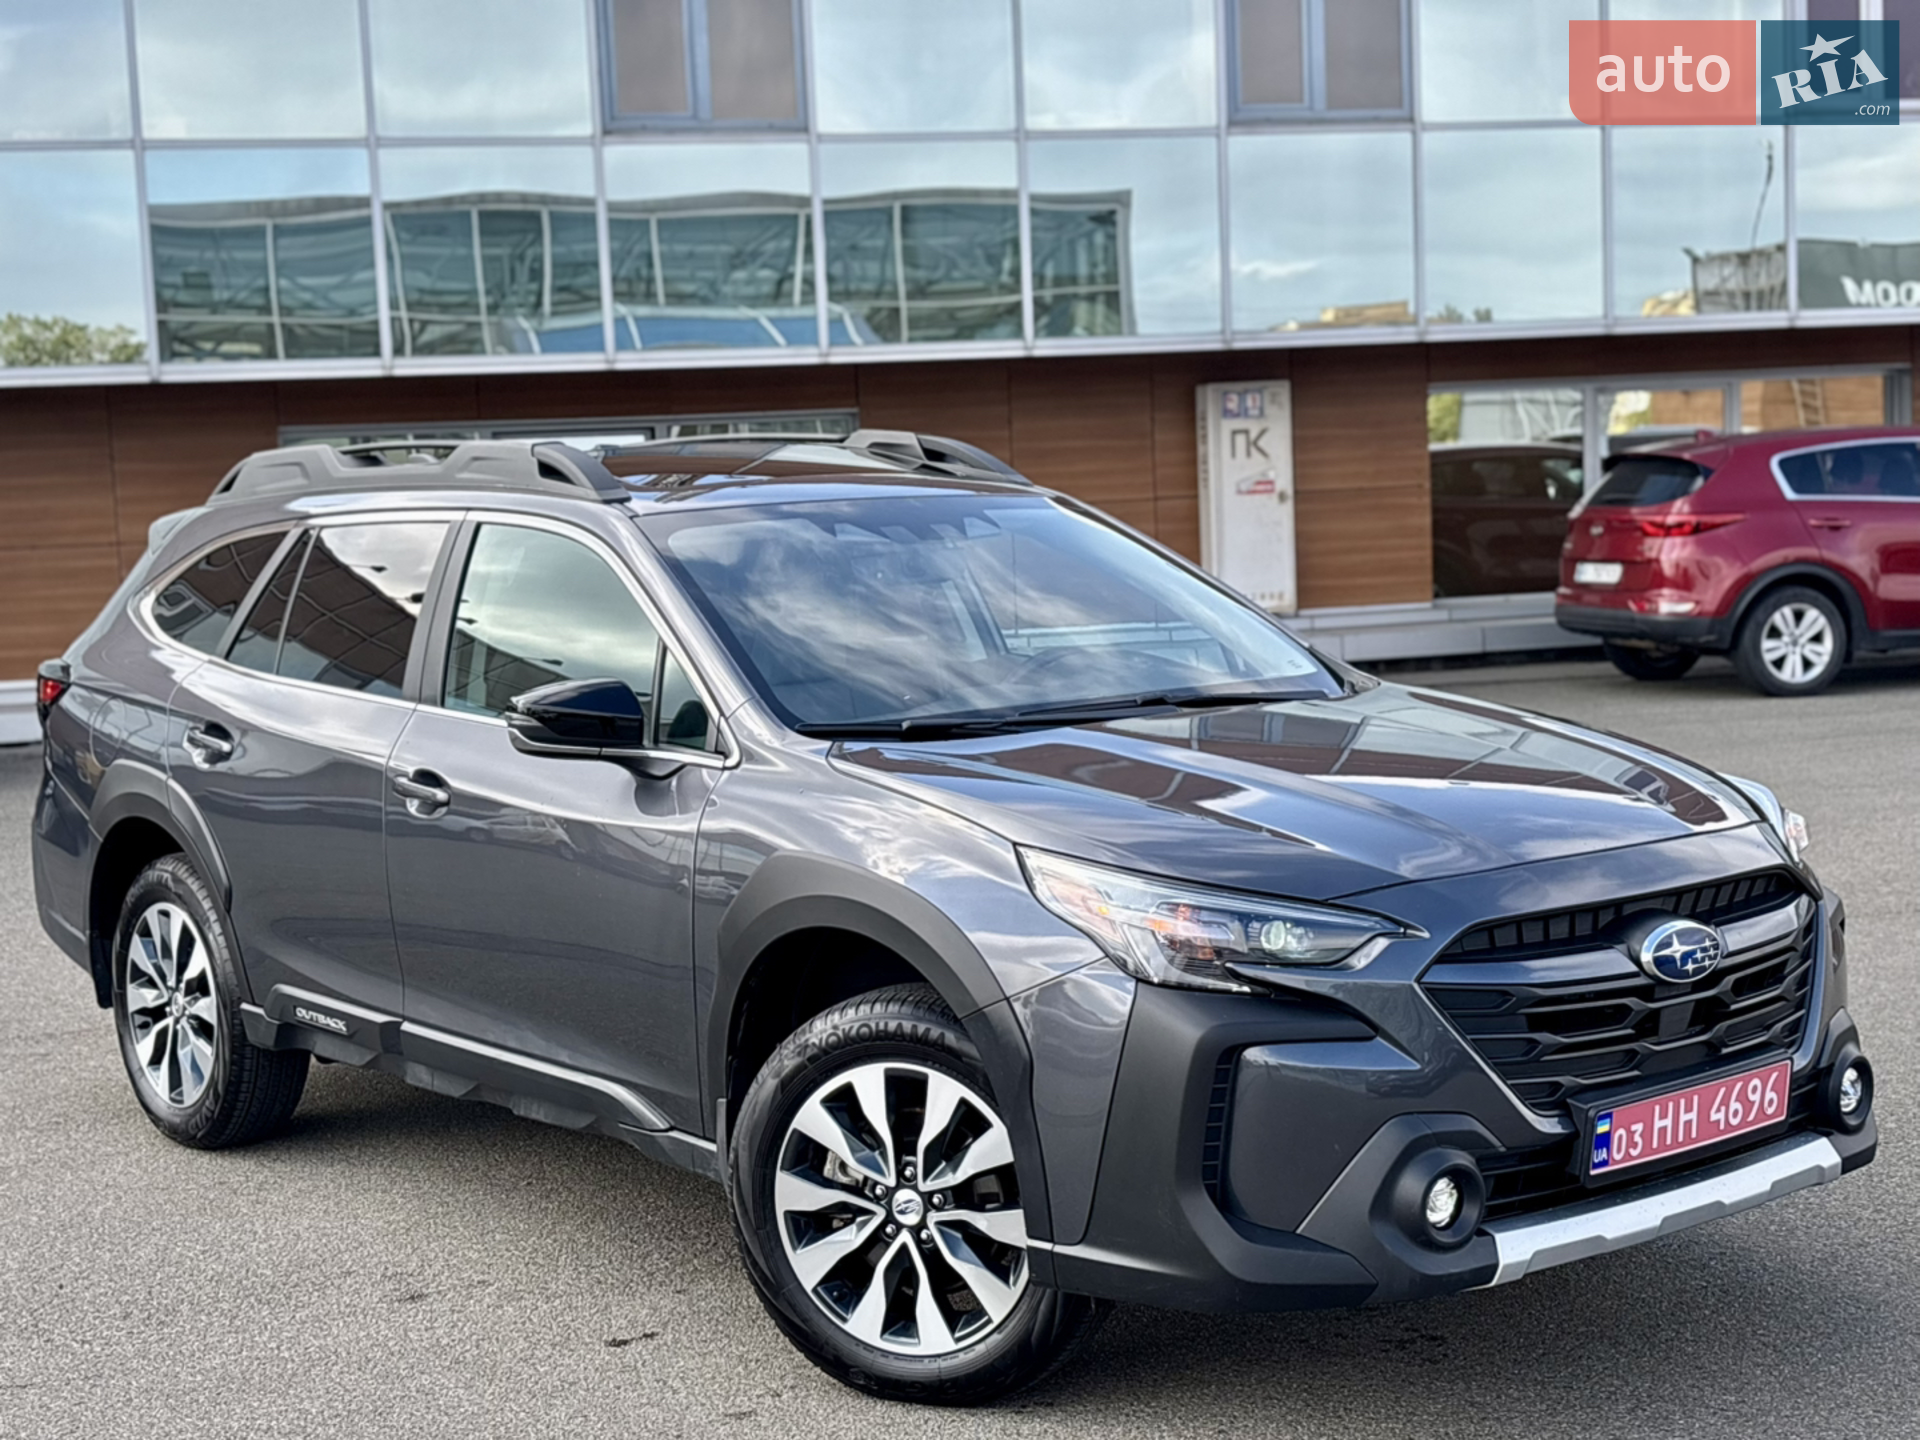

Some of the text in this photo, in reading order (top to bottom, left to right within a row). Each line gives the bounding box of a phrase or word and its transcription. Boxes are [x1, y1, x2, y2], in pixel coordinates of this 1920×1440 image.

[295, 1006, 348, 1033] OUTBACK
[811, 1021, 949, 1056] YOKOHAMA
[1612, 1071, 1780, 1161] 03 HH 4696
[1593, 1147, 1608, 1164] UA
